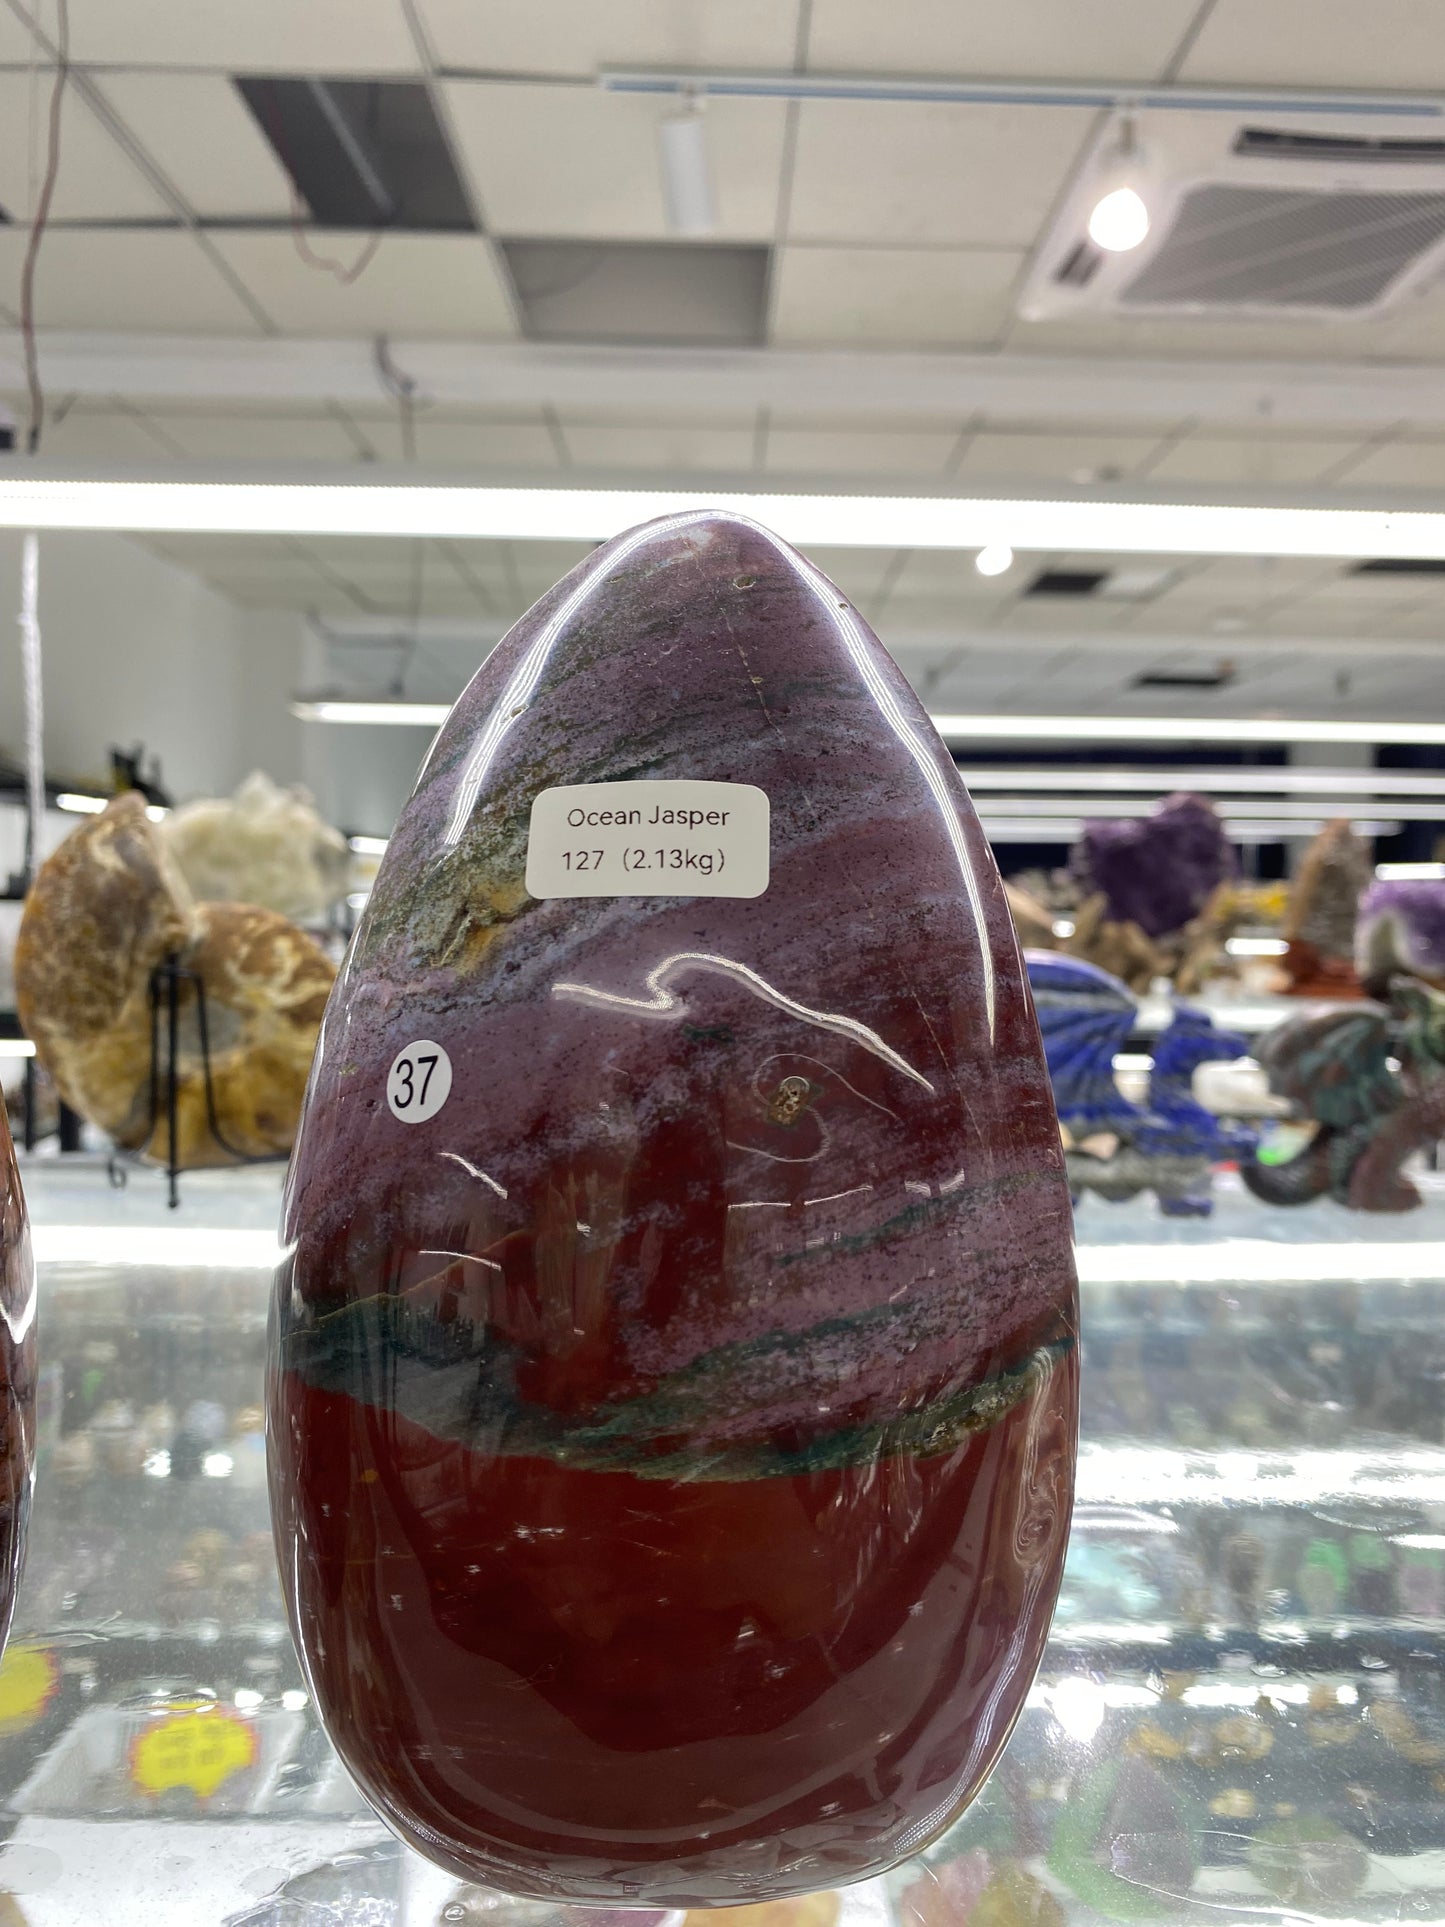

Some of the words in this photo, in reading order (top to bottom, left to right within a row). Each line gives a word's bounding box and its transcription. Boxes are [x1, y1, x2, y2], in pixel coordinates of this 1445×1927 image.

[567, 808, 641, 827] Ocean
[648, 805, 730, 830] Jasper
[561, 850, 604, 870] 127
[623, 848, 725, 875] (2.13kg)
[394, 1055, 439, 1109] 37
